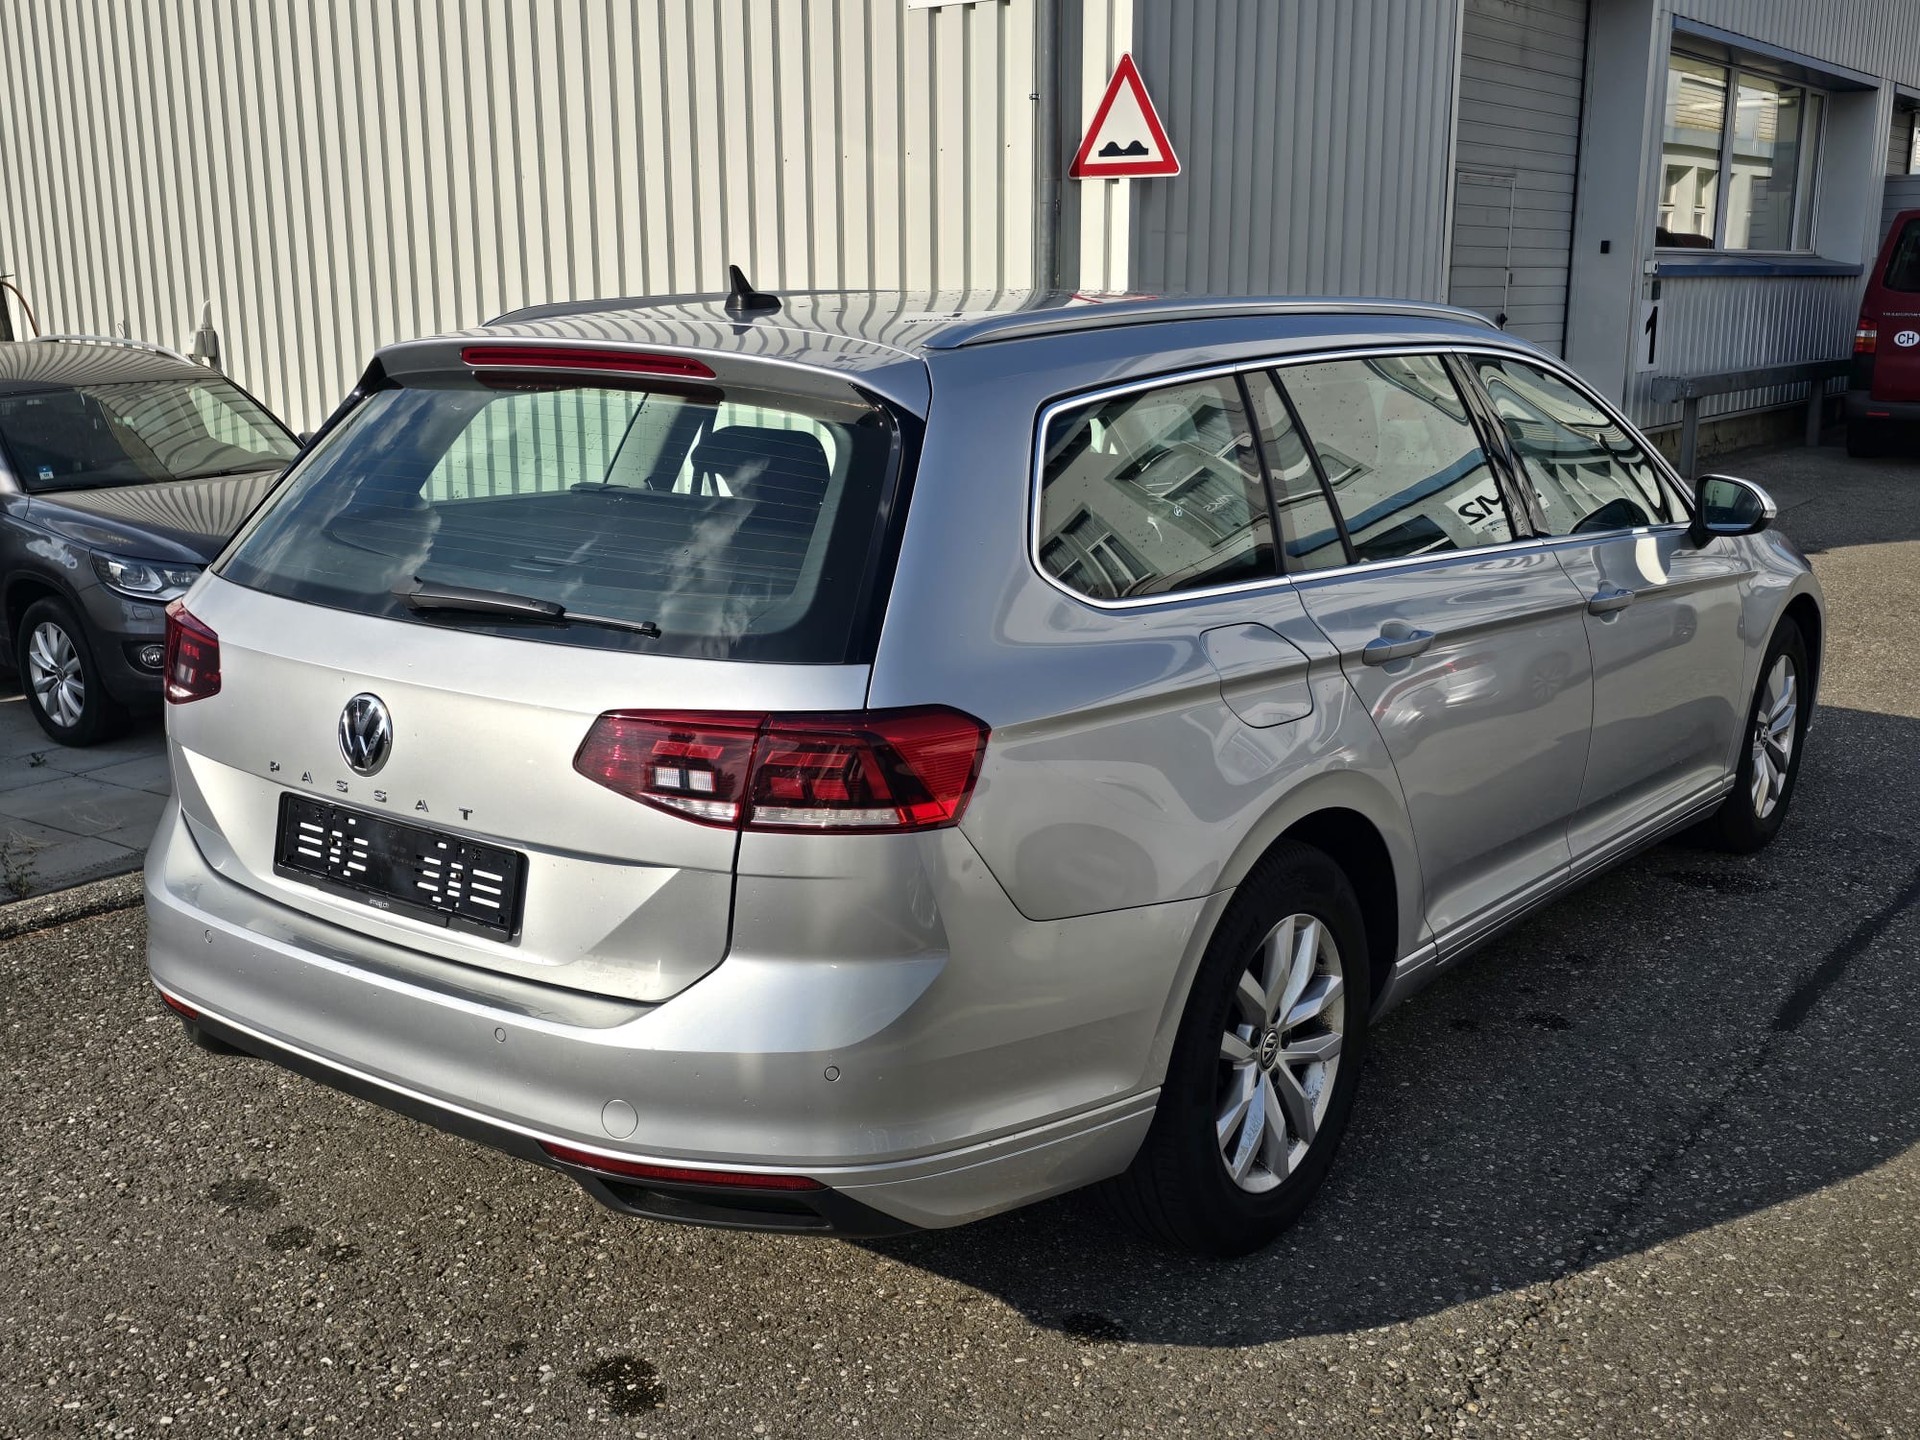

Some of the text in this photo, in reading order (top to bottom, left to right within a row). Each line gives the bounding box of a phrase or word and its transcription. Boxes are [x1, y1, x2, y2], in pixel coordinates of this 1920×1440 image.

[1645, 306, 1658, 364] 1
[1897, 333, 1915, 344] CH
[269, 761, 473, 820] PASSAT
